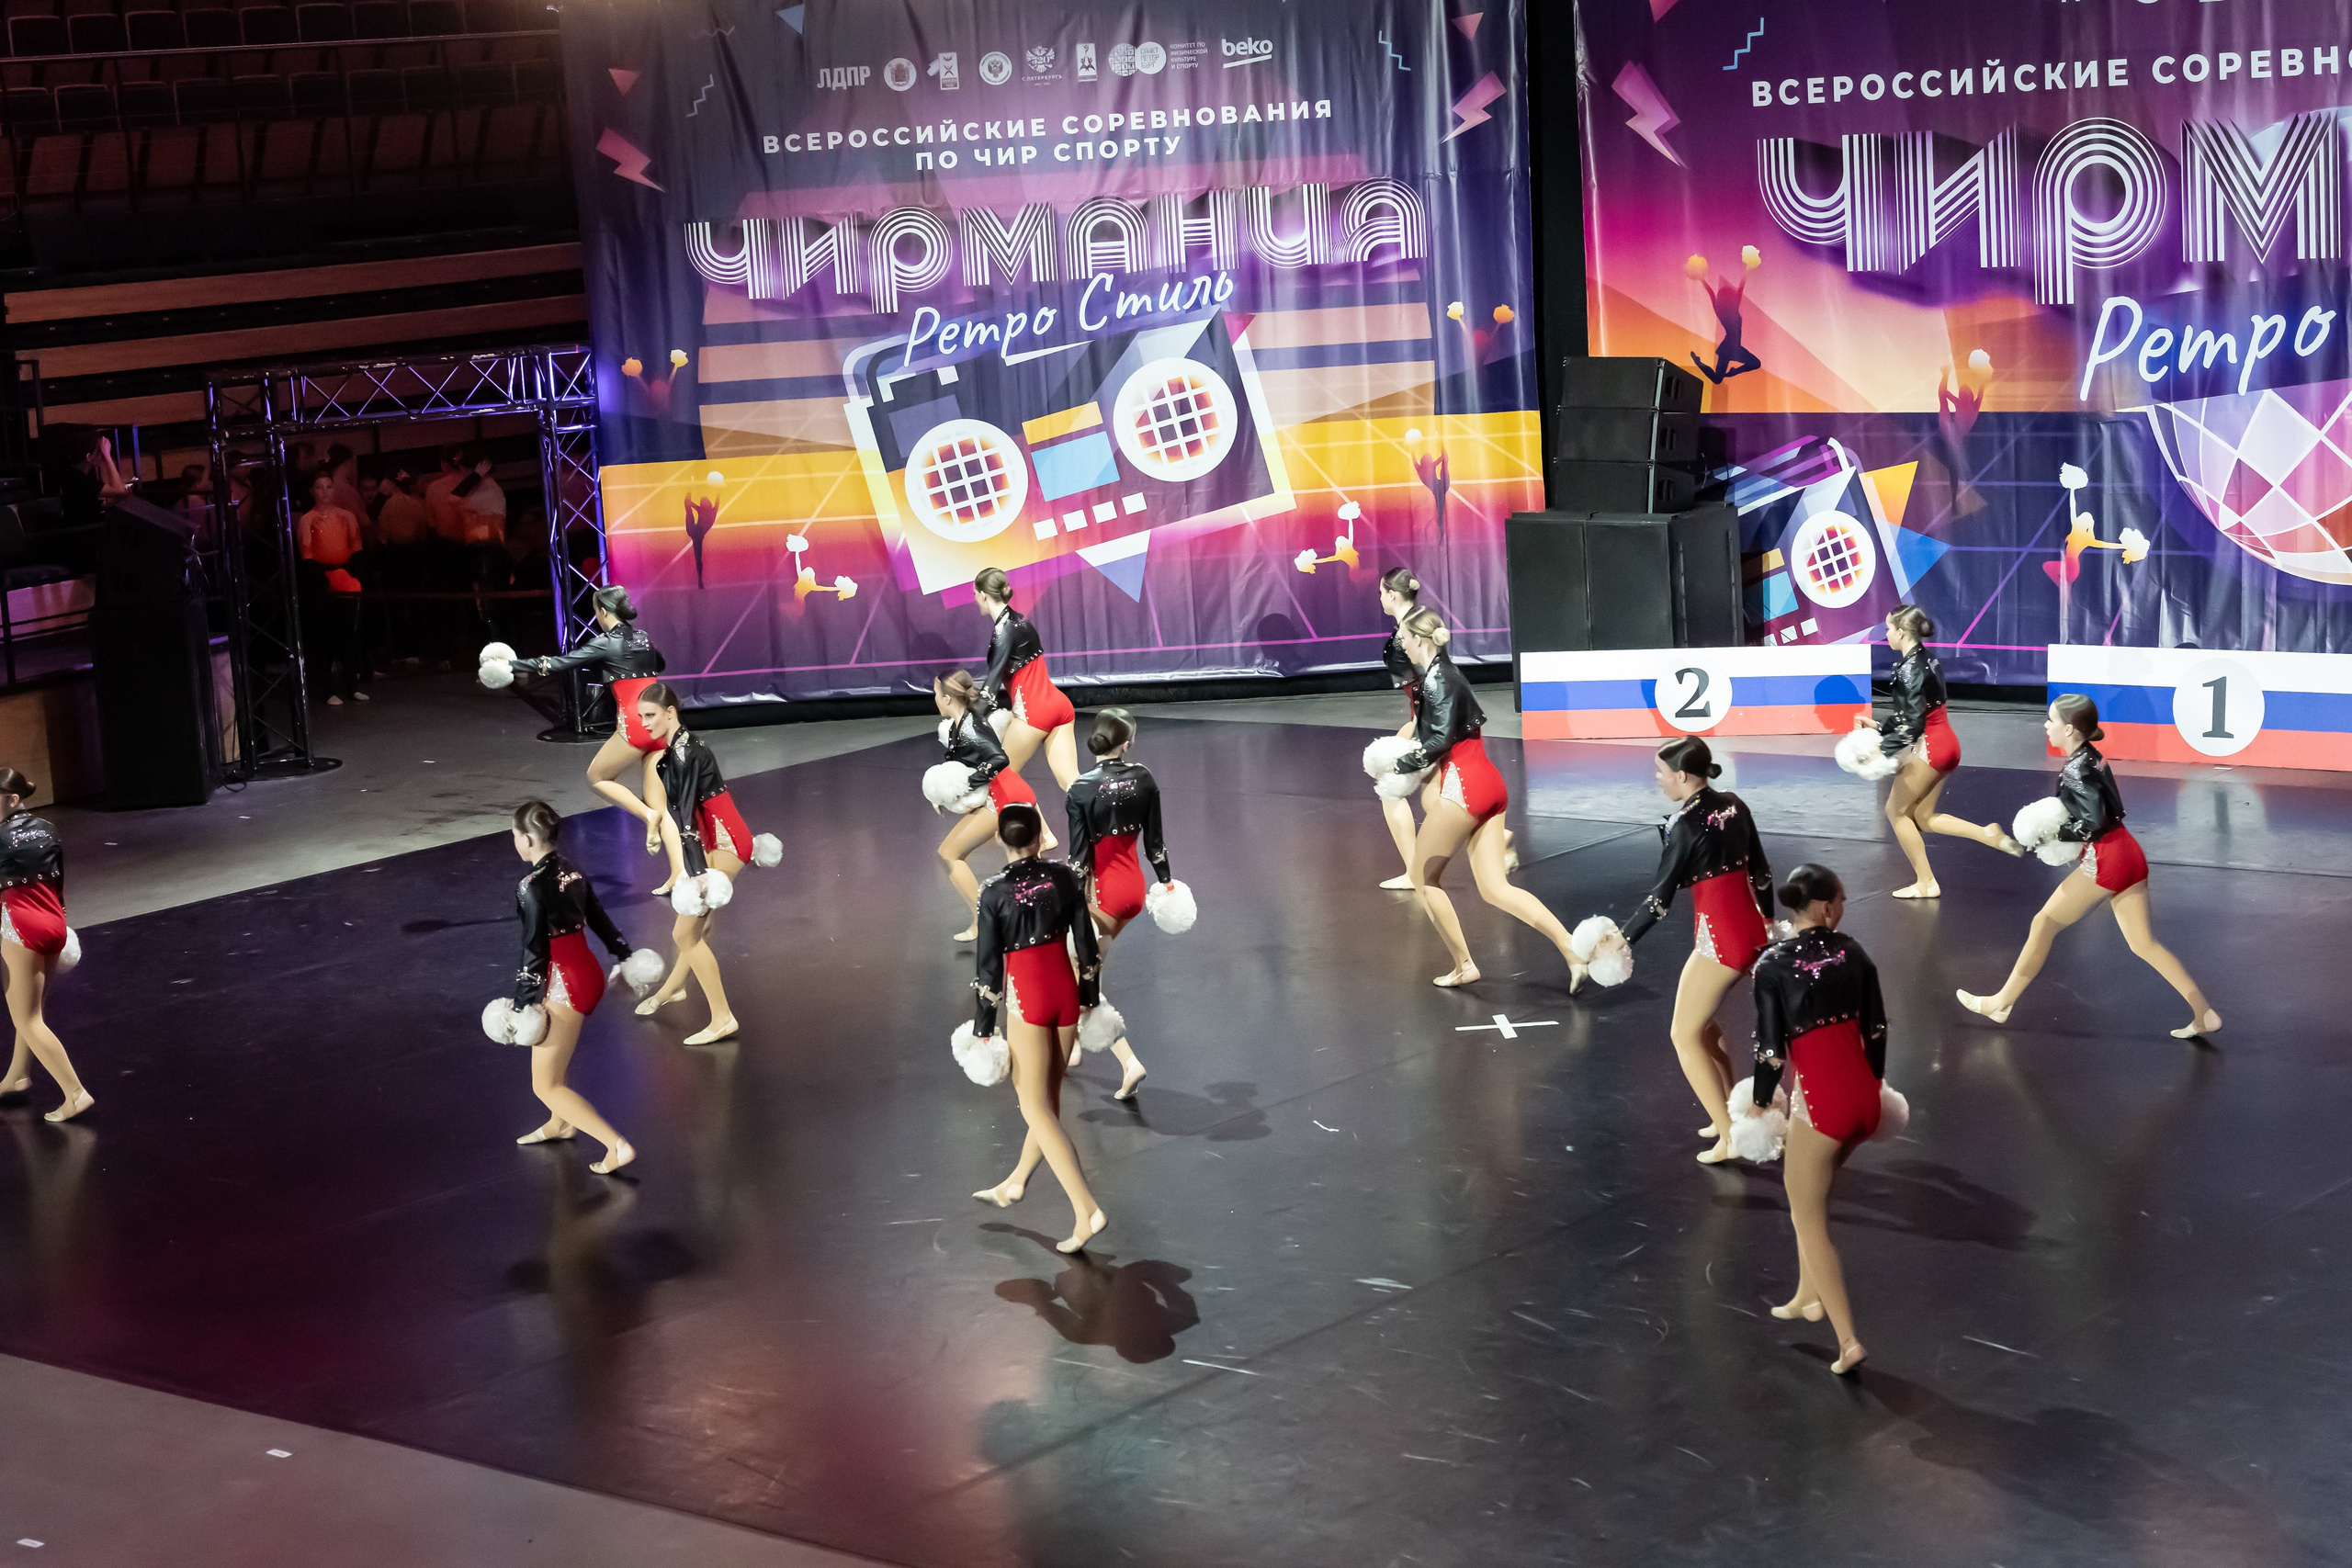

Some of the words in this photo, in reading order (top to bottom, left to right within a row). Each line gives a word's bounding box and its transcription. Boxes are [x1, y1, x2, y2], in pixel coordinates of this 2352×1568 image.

[1170, 48, 1208, 56] ФИЗИЧЕСКОЙ
[1221, 38, 1273, 56] beko
[817, 65, 871, 90] ЛДПР
[1752, 58, 2129, 107] ВСЕРОССИЙСКИЕ
[2152, 46, 2352, 85] СОРЕВН
[763, 118, 1046, 153] ВСЕРОССИЙСКИЕ
[1062, 99, 1332, 134] СОРЕВНОВАНИЯ
[916, 150, 957, 172] ПО
[974, 146, 1037, 167] ЧИР
[1054, 135, 1182, 164] СПОРТУ
[1757, 111, 2342, 305] ЧИРМ
[903, 306, 1057, 367] Ретро
[1079, 271, 1235, 332] Стиль
[2079, 295, 2336, 401] Ретро
[1674, 667, 1711, 718] 2
[2201, 675, 2235, 739] 1
